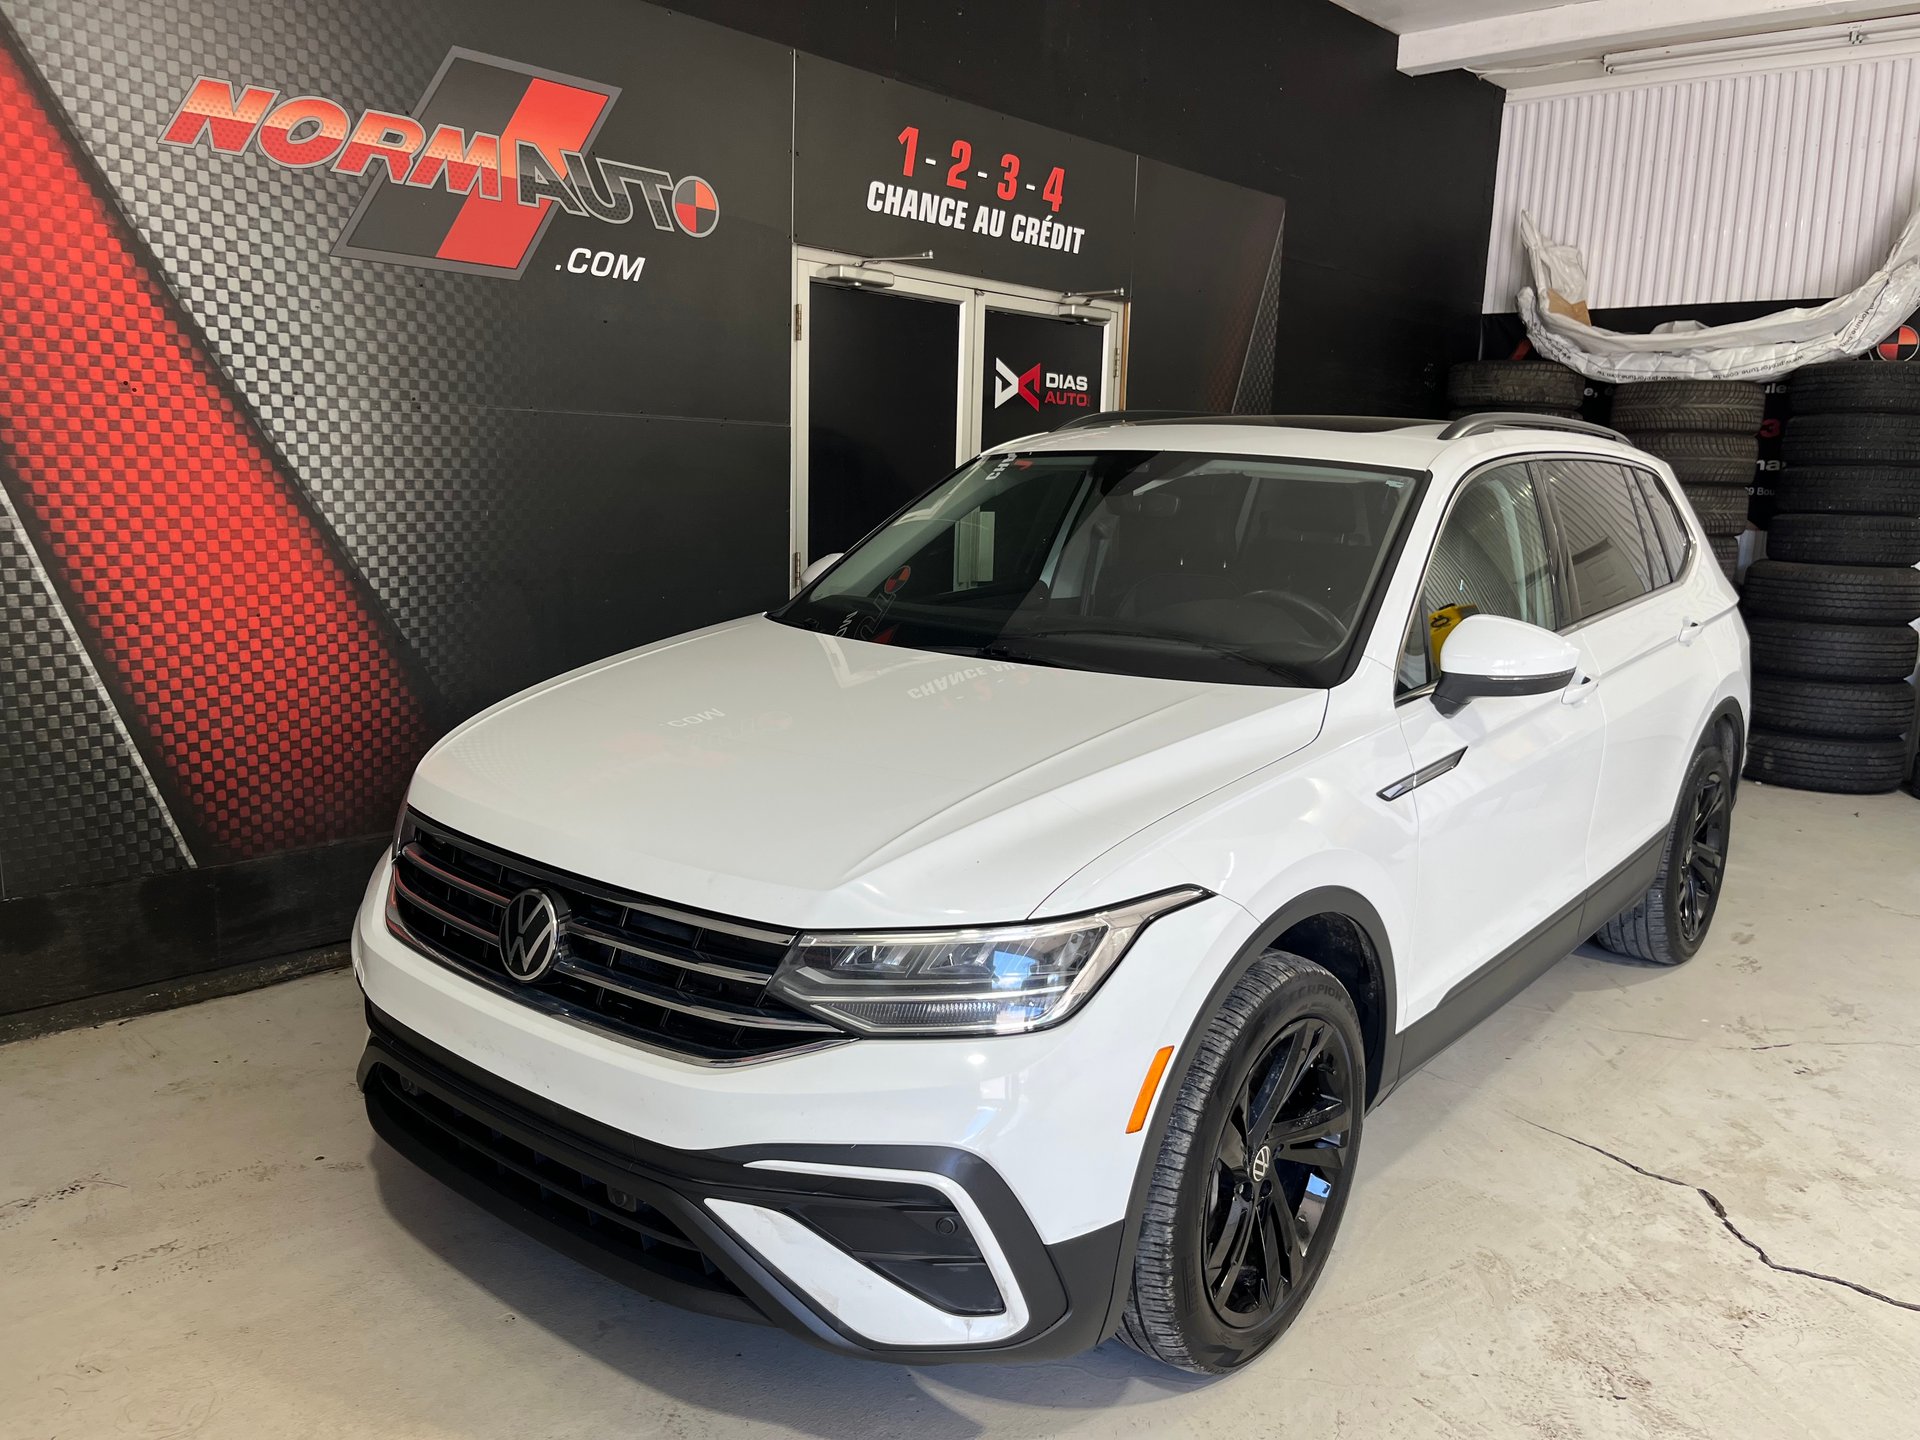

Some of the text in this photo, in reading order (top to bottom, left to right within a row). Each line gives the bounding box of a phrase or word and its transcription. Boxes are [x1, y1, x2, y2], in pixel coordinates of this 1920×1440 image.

[866, 180, 1085, 254] CHANCE AU CRÉDIT
[1045, 372, 1088, 392] DIAS
[1044, 390, 1088, 407] AUTO
